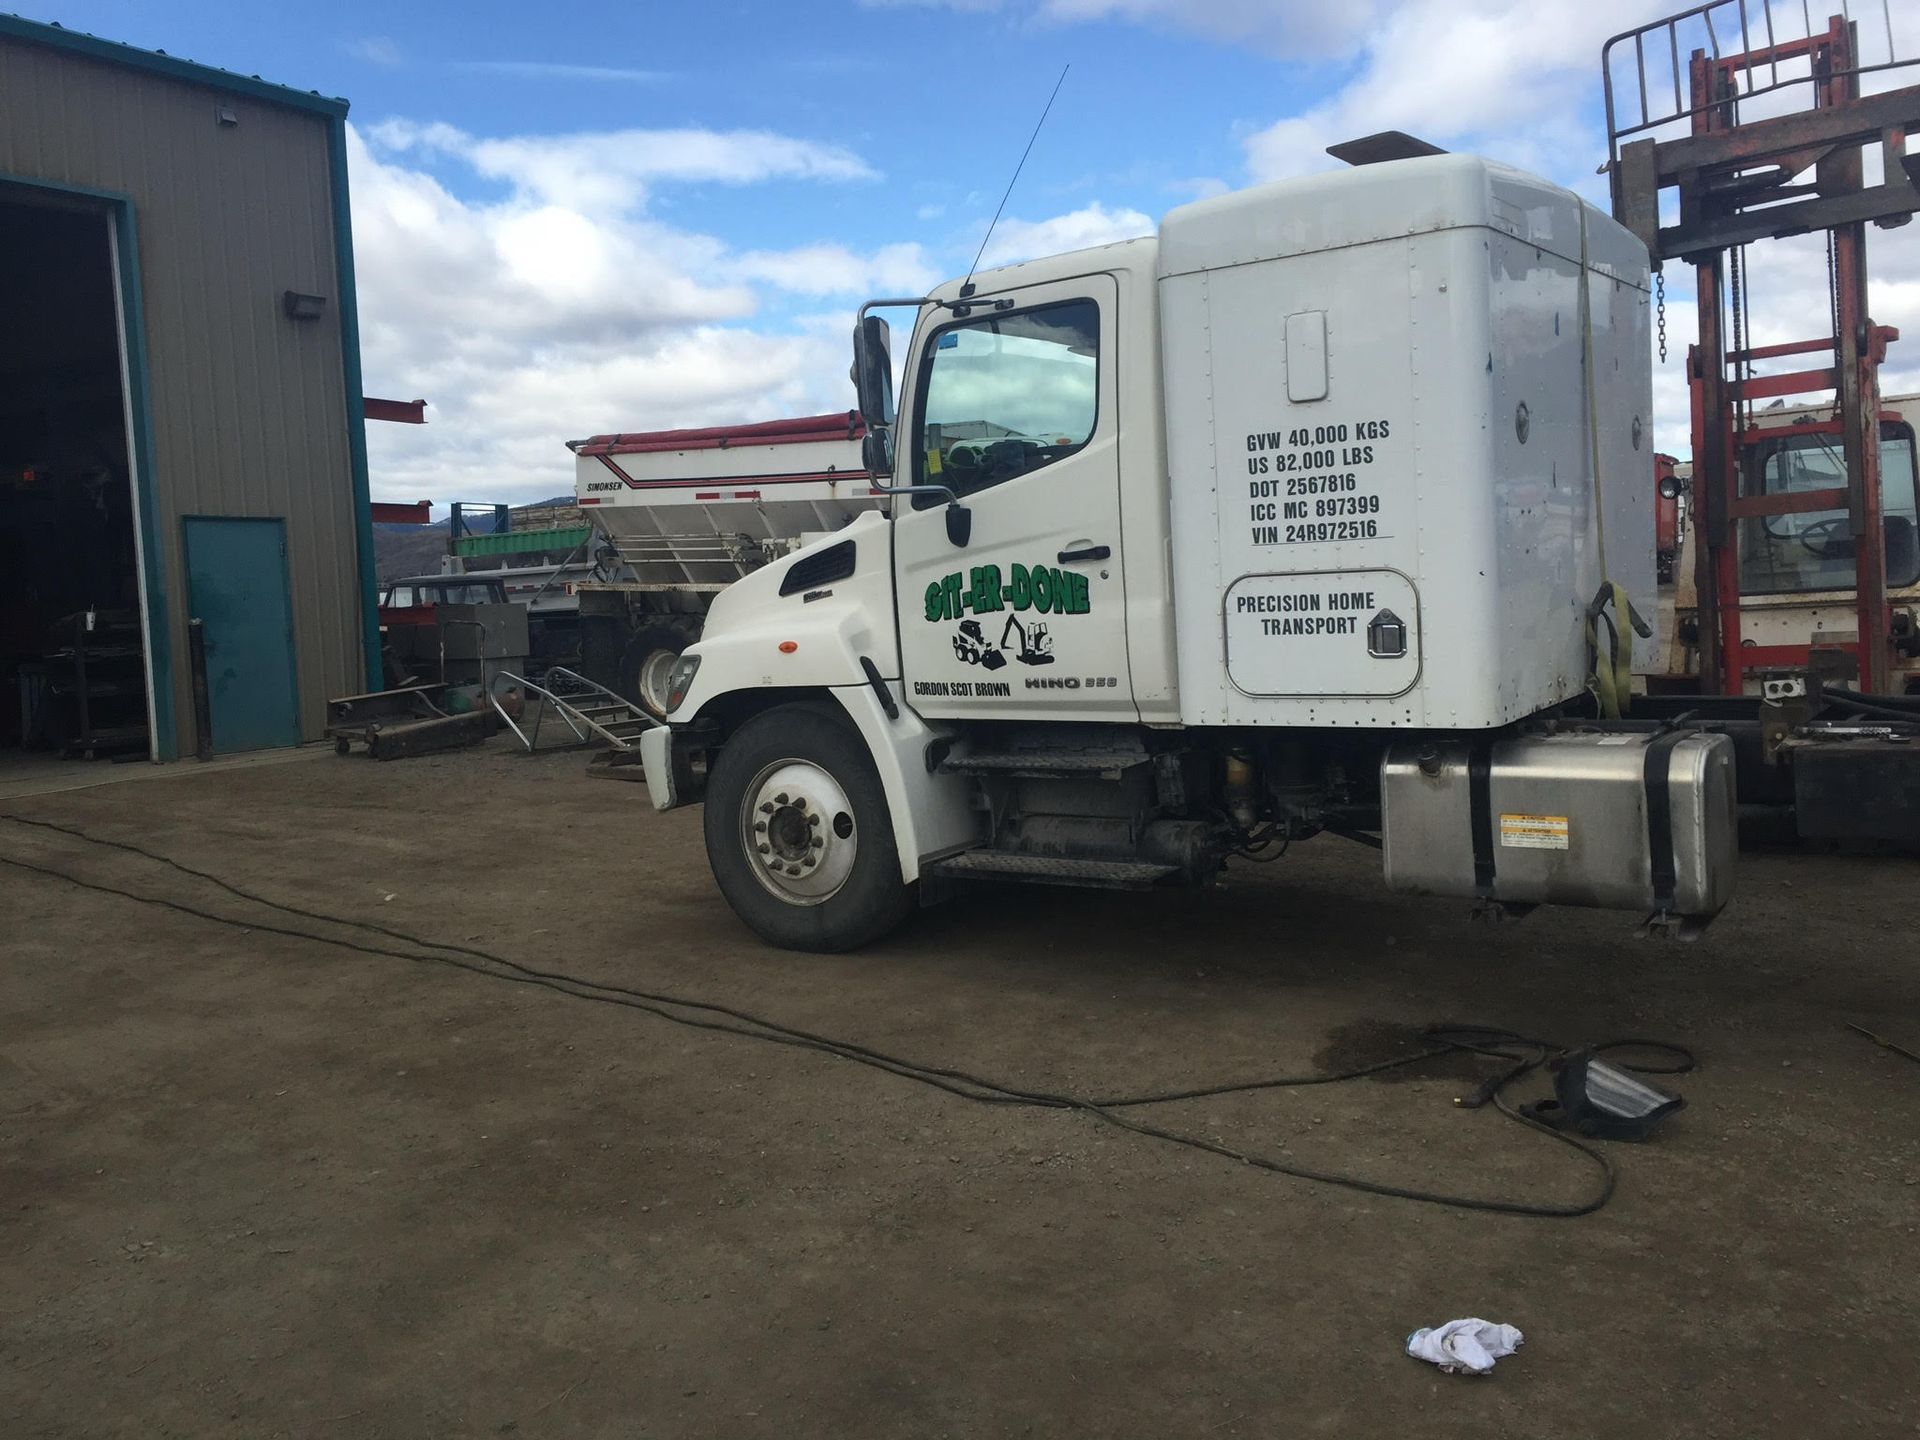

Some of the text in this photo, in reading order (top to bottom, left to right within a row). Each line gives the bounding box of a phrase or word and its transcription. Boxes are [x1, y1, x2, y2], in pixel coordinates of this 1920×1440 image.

[1247, 420, 1390, 452] GVW 40,000 KGS
[1248, 446, 1374, 475] US 82,000 LBS
[587, 481, 623, 492] SIMONSEN
[1250, 473, 1356, 498] DOT 2567816
[1251, 495, 1380, 521] ICC MC 897399
[1252, 520, 1377, 544] VIN 24R972516
[924, 563, 1091, 622] GIT-ER-DONE
[1237, 592, 1375, 613] PRECISION HOME
[1261, 617, 1358, 635] TRANSPORT
[914, 681, 1011, 696] GORDON SCOT BROWN
[1025, 677, 1080, 689] HINO
